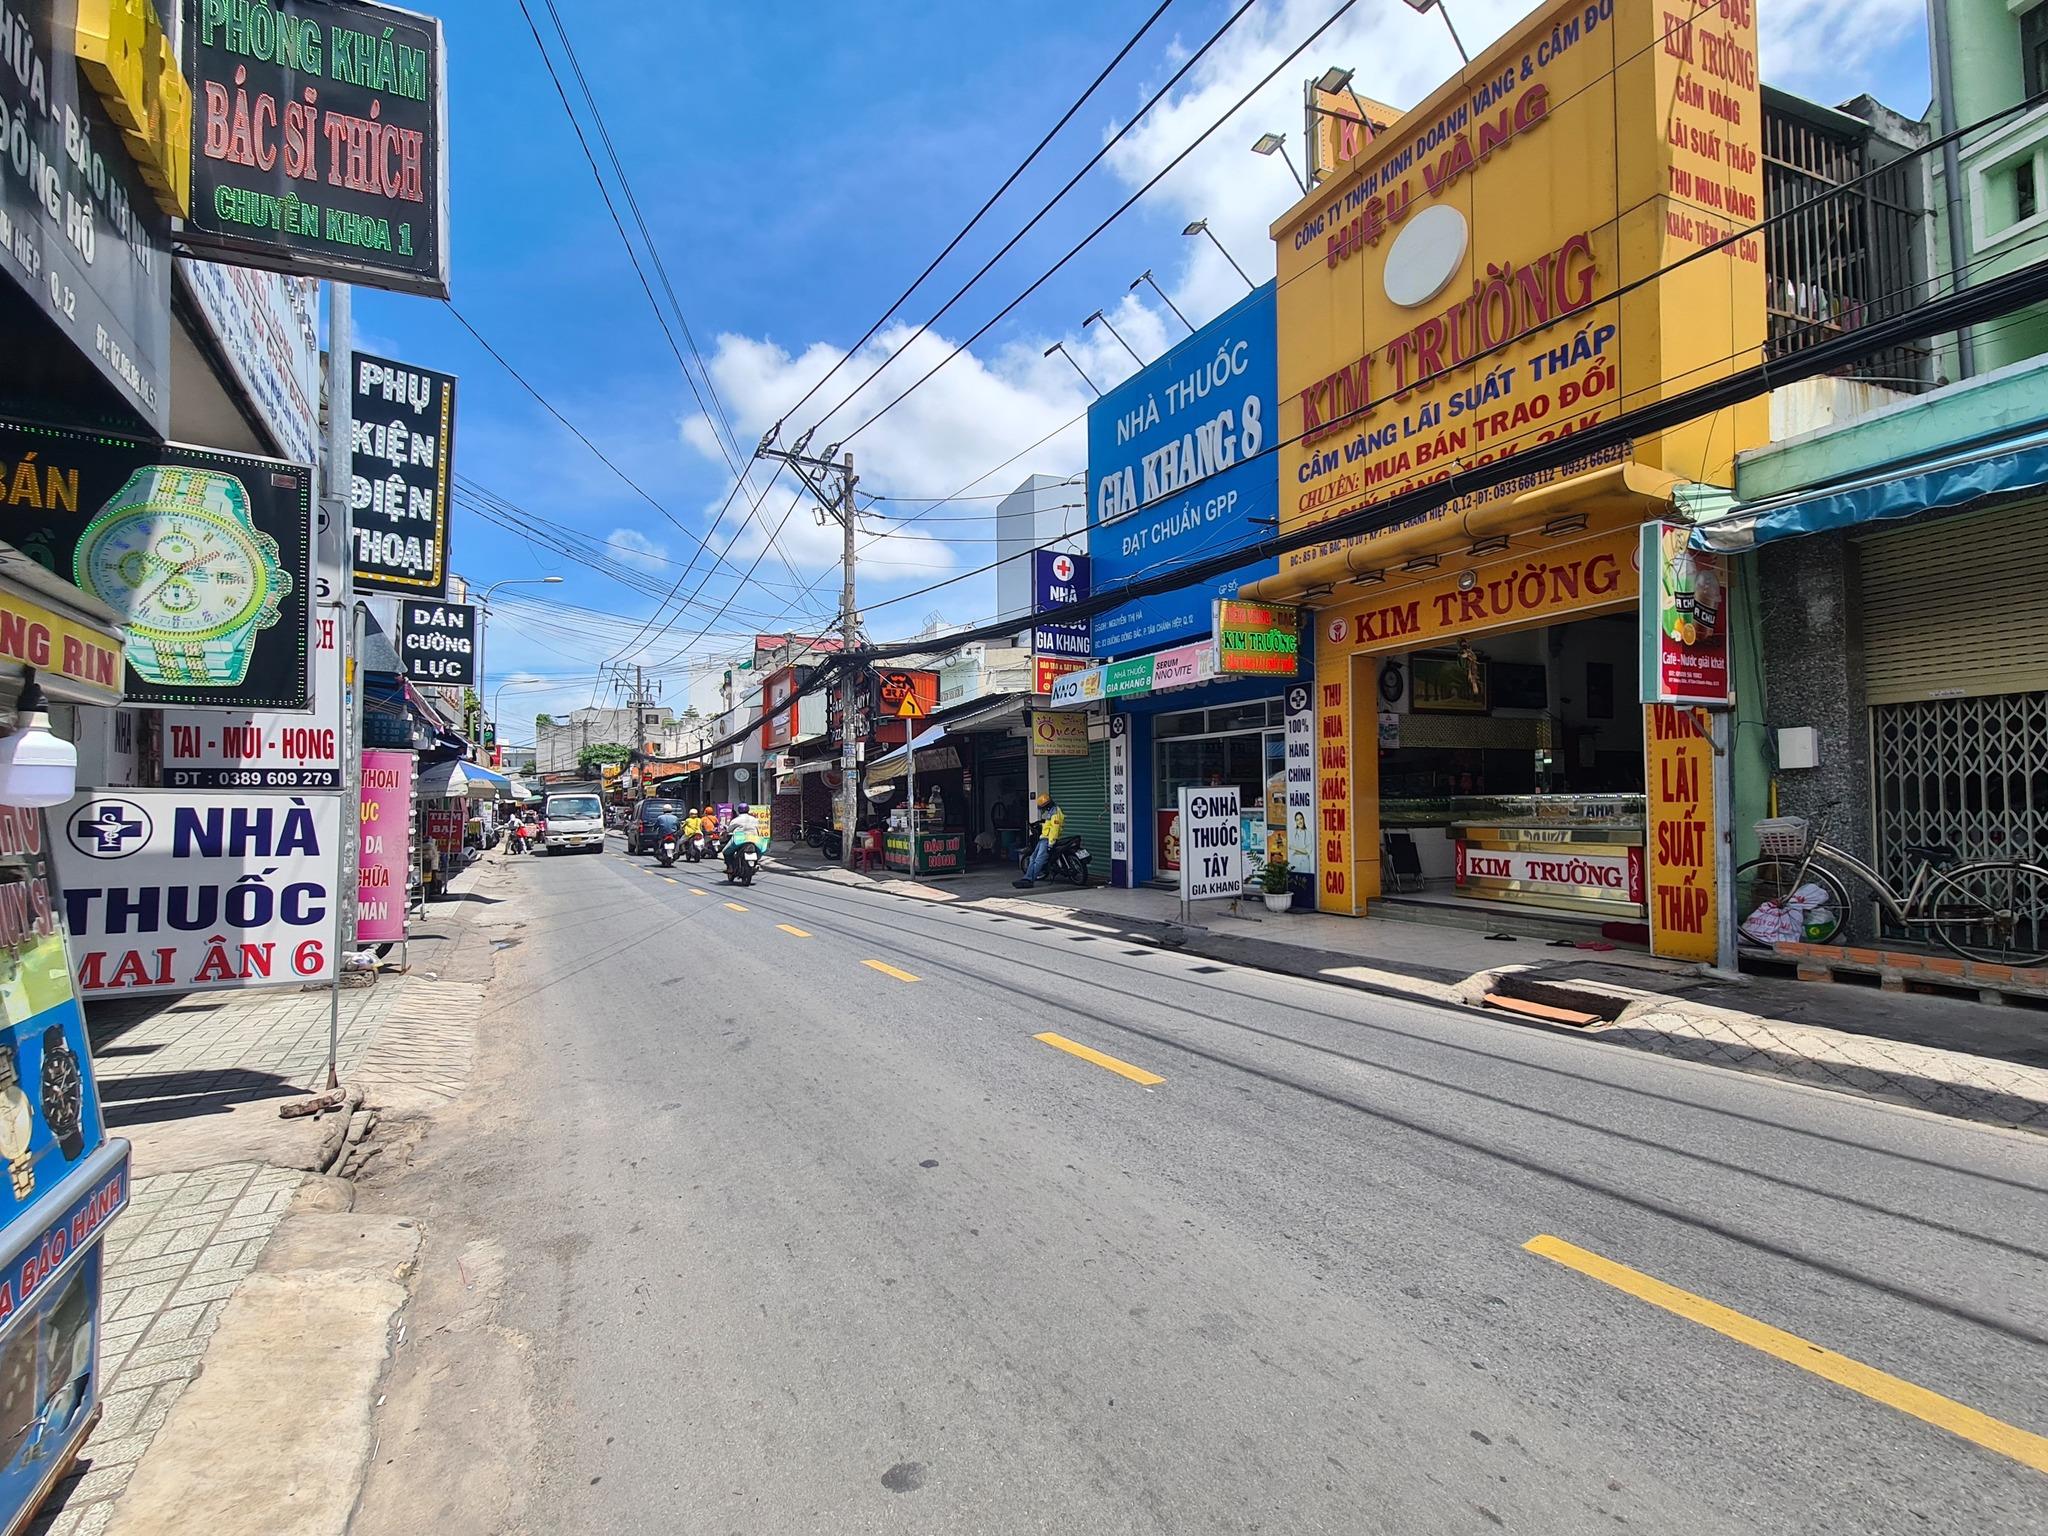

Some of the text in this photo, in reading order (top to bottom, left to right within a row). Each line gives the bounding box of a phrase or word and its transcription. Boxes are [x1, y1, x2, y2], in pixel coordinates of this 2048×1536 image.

[331, 27, 427, 101] KHÁM
[1663, 11, 1755, 92] KIM TRƯỜNG
[1708, 87, 1741, 127] VÀNG
[204, 64, 425, 203] BÁC SĨ THÍCH
[1295, 22, 1580, 251] CÔNG TY TNHH KINH DOANH VÀNG & CẦM
[1667, 115, 1757, 176] LÃI SUẤT THẤP
[65, 103, 106, 201] BẢO
[110, 175, 152, 276] HÀNH
[1327, 83, 1550, 270] HIỆU VÀNG
[1668, 165, 1756, 222] THU MUA VÀNG
[66, 189, 96, 265] HỒ
[214, 184, 414, 256] CHUYÊN KHOA 1
[1666, 210, 1693, 246] KHÁC
[1695, 219, 1719, 248] TIỆM
[1740, 238, 1759, 264] CAO
[1300, 231, 1600, 448] KIM TRƯỜNG
[359, 359, 431, 415] PHỤ
[1117, 338, 1249, 446] NHÀ THUỐC
[1298, 319, 1617, 485] CẦM VÀNG LÃI SUẤT THẤP
[352, 419, 435, 469] KIỆN
[1298, 356, 1617, 514] CHUYÊN: MUA BÁN TRAO ĐỔI
[1097, 394, 1263, 529] GIA KHANG 8
[351, 473, 433, 523] ĐIỆN
[1494, 479, 1517, 500] 0933
[1122, 490, 1238, 556] ĐẠT CHUẨN GPP
[1049, 584, 1078, 604] NHÀ
[1355, 553, 1621, 645] KIM TRƯỜNG
[413, 606, 464, 629] DÁN
[406, 631, 471, 654] CƯỜNG
[1036, 631, 1091, 655] GIA KHANG
[1223, 630, 1247, 650] KIM
[63, 634, 116, 688] RIN
[414, 658, 462, 679] LỰC
[1113, 663, 1147, 679] NHÀ THUỐC
[1155, 664, 1193, 680] NNO VITE
[1156, 658, 1179, 670] SERUM
[1106, 683, 1118, 693] GIA
[1119, 677, 1146, 691] KHANG
[1146, 676, 1152, 686] 8
[1323, 683, 1342, 709] THU
[170, 725, 200, 759] TAI
[223, 721, 262, 759] MŨI
[283, 728, 335, 767] HỌNG
[475, 722, 495, 732] SPA
[1288, 718, 1310, 734] 100%
[1323, 716, 1344, 739] MUA
[1288, 740, 1310, 759] HÀNG
[1321, 741, 1346, 770] VÀNG
[174, 771, 333, 786] ĐT 0389 609 279
[360, 768, 400, 793] THOẠI
[1287, 767, 1312, 783] CHÍNH
[1321, 771, 1347, 801] KHÁC
[1661, 745, 1699, 803] LÃI
[1210, 792, 1239, 817] NHÀ
[1289, 790, 1311, 807] HÃNG
[173, 797, 321, 858] NHÀ
[1192, 819, 1238, 849] THUỐC
[1323, 803, 1346, 839] TIỆM
[1657, 803, 1706, 868] SUẤT
[365, 835, 384, 855] DA
[1327, 833, 1343, 864] GIÁ
[1203, 853, 1229, 878] TÂY
[1325, 870, 1345, 895] CAO
[1470, 856, 1624, 888] KIM TRƯỜNG
[63, 867, 327, 936] THUỐC
[1192, 881, 1240, 896] GIA KHANG
[1657, 868, 1709, 935] THẤP
[357, 897, 388, 921] MÀN
[191, 934, 276, 985] ÂN
[291, 939, 325, 976] 6
[20, 1228, 67, 1301] BẢO
[71, 1174, 122, 1249] HÀNH
